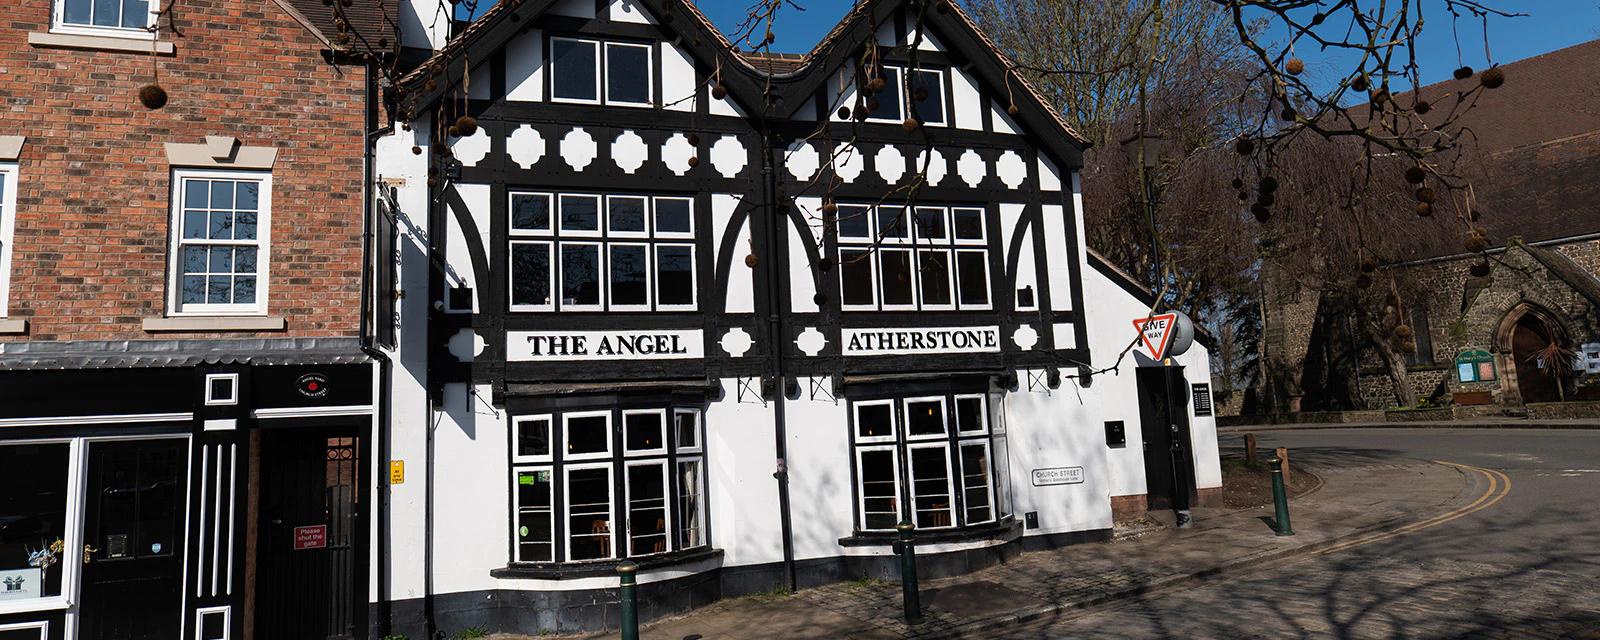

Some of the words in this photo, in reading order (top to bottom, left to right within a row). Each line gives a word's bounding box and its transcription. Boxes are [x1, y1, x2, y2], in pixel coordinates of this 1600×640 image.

[847, 330, 997, 351] ATHERSTONE
[1147, 331, 1162, 339] WAY
[527, 335, 588, 356] THE
[596, 335, 687, 356] ANGEL
[1060, 469, 1080, 477] STREET
